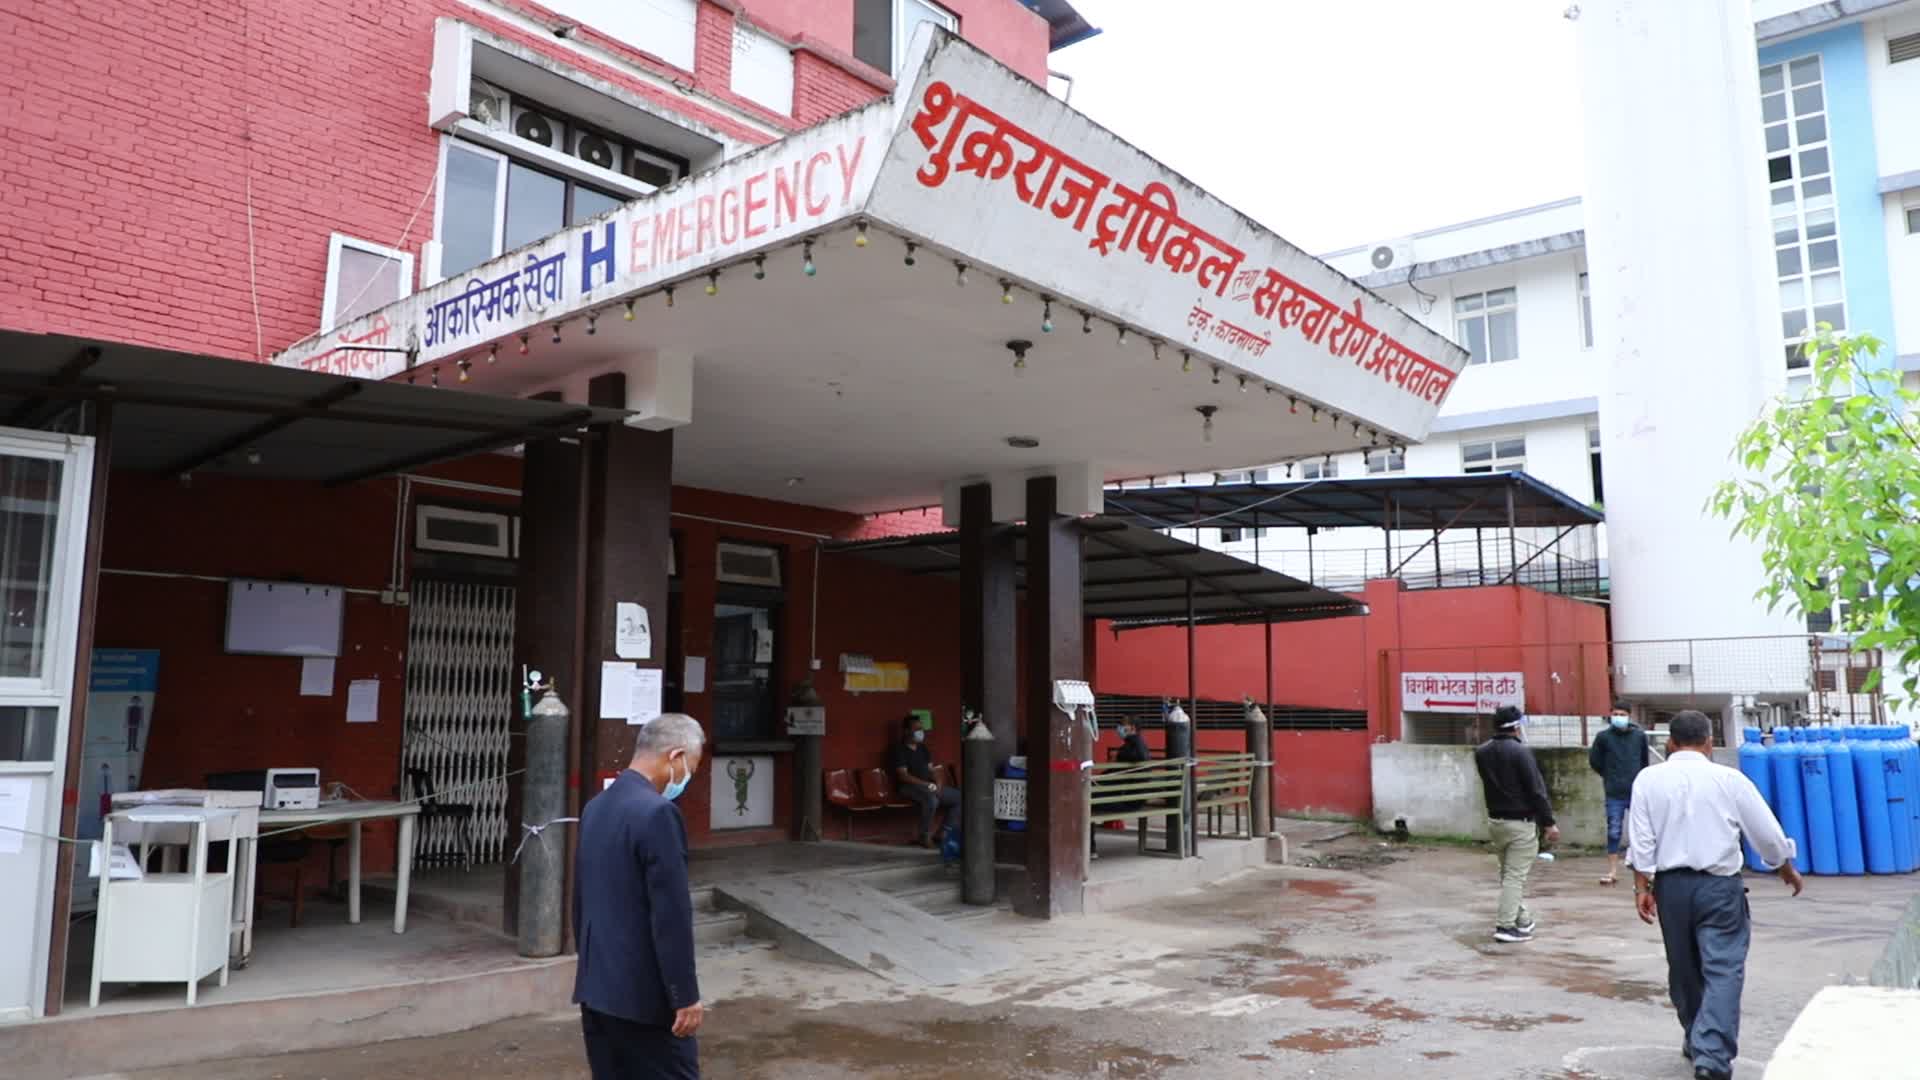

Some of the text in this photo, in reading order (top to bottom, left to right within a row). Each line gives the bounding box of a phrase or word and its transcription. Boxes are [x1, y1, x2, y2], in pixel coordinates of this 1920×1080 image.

[581, 136, 866, 293] H EMERGENCY
[424, 252, 566, 348] आकस्मिक सेवा
[1328, 297, 1379, 366] रोग
[1364, 332, 1457, 406] अस्पताल
